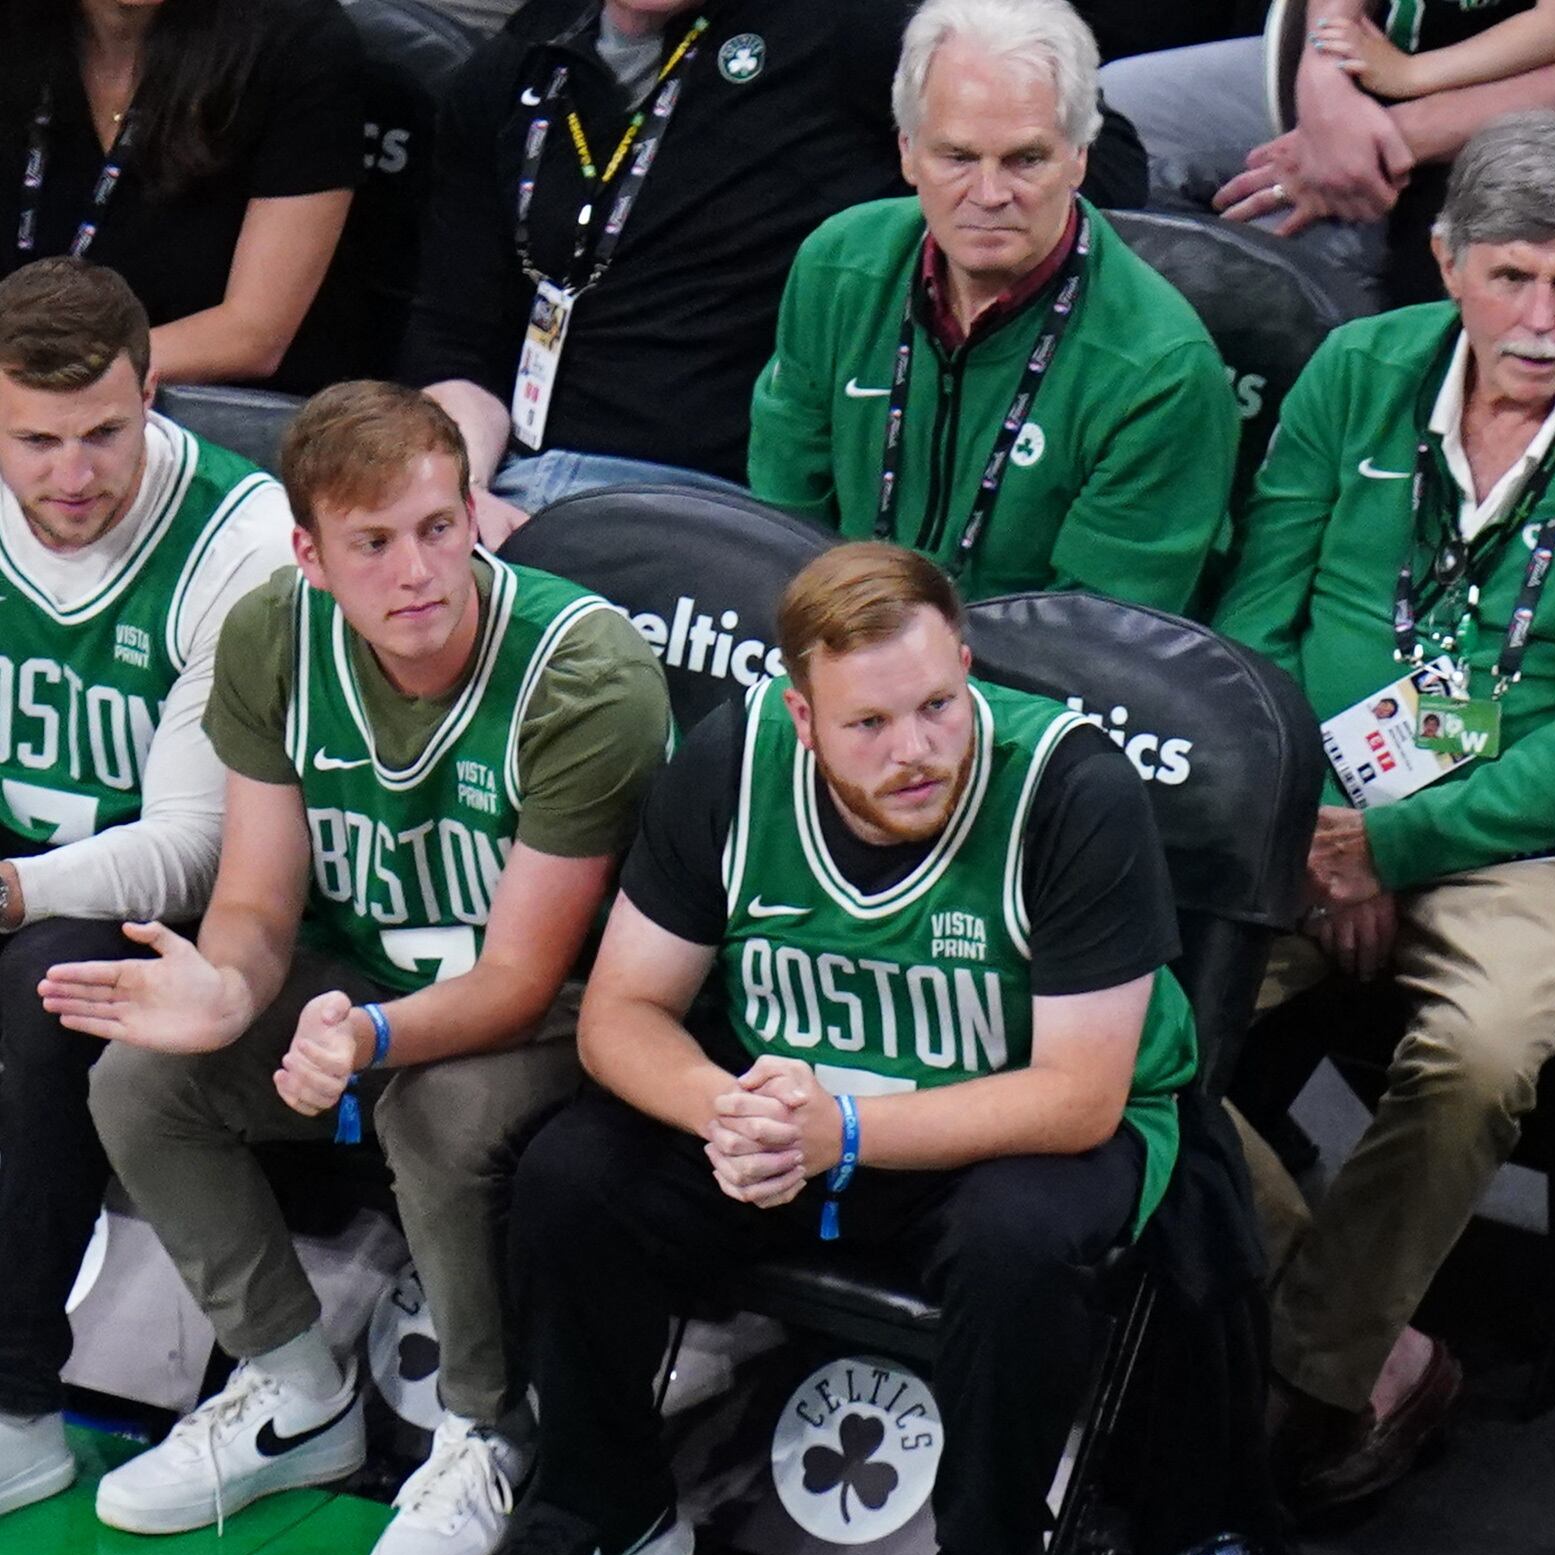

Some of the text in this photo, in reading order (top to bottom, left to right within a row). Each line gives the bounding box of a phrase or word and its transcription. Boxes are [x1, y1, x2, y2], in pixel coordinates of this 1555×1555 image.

[114, 645, 150, 671] PRINT
[115, 624, 150, 651] VISTA
[614, 597, 787, 686] eltics
[456, 760, 497, 791] VISTA
[2, 778, 99, 845] 7
[458, 783, 498, 815] PRINT
[307, 807, 514, 926] BOSTON
[931, 911, 987, 942] VISTA
[379, 925, 476, 984] 7
[931, 939, 987, 961] PRINT
[742, 937, 1008, 1072] BOSTON
[796, 1368, 934, 1451] CELTICS
